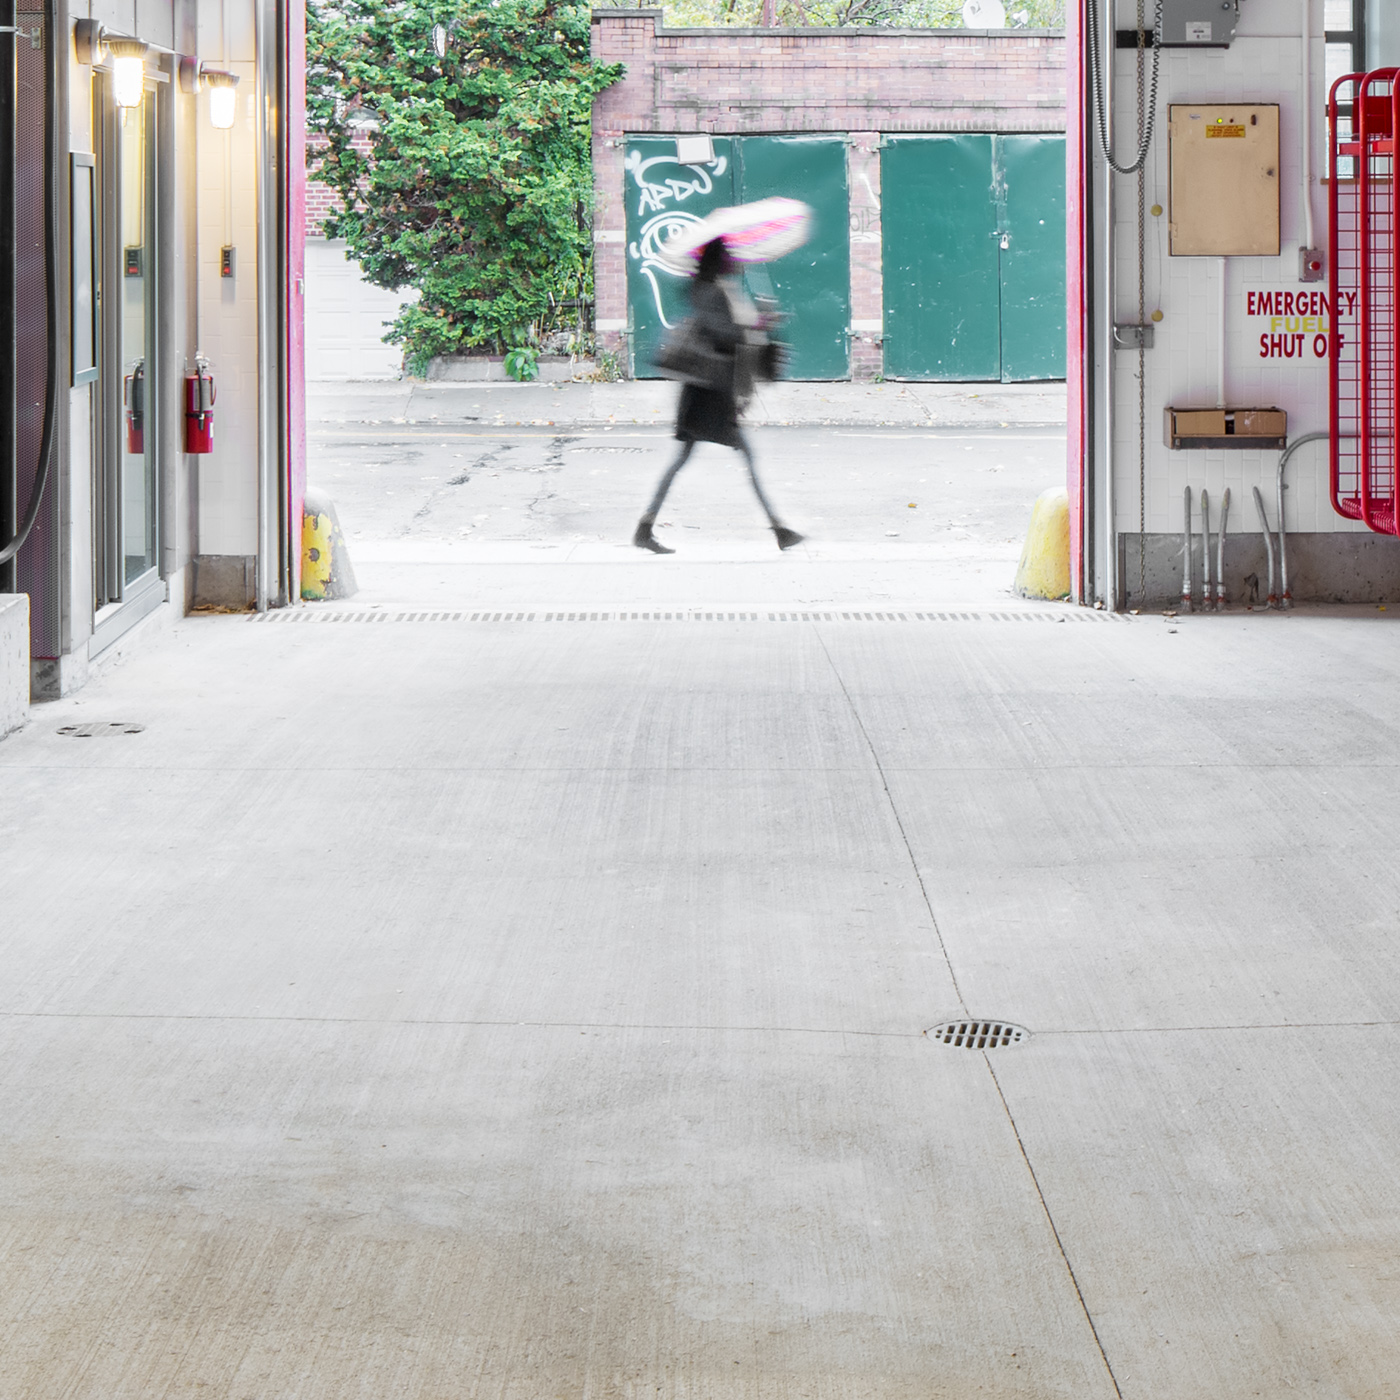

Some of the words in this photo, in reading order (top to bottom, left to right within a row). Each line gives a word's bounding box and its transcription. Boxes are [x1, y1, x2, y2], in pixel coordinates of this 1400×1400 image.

[1270, 317, 1329, 333] FUEL
[1259, 333, 1305, 358] SHUT
[1313, 333, 1345, 358] OF
